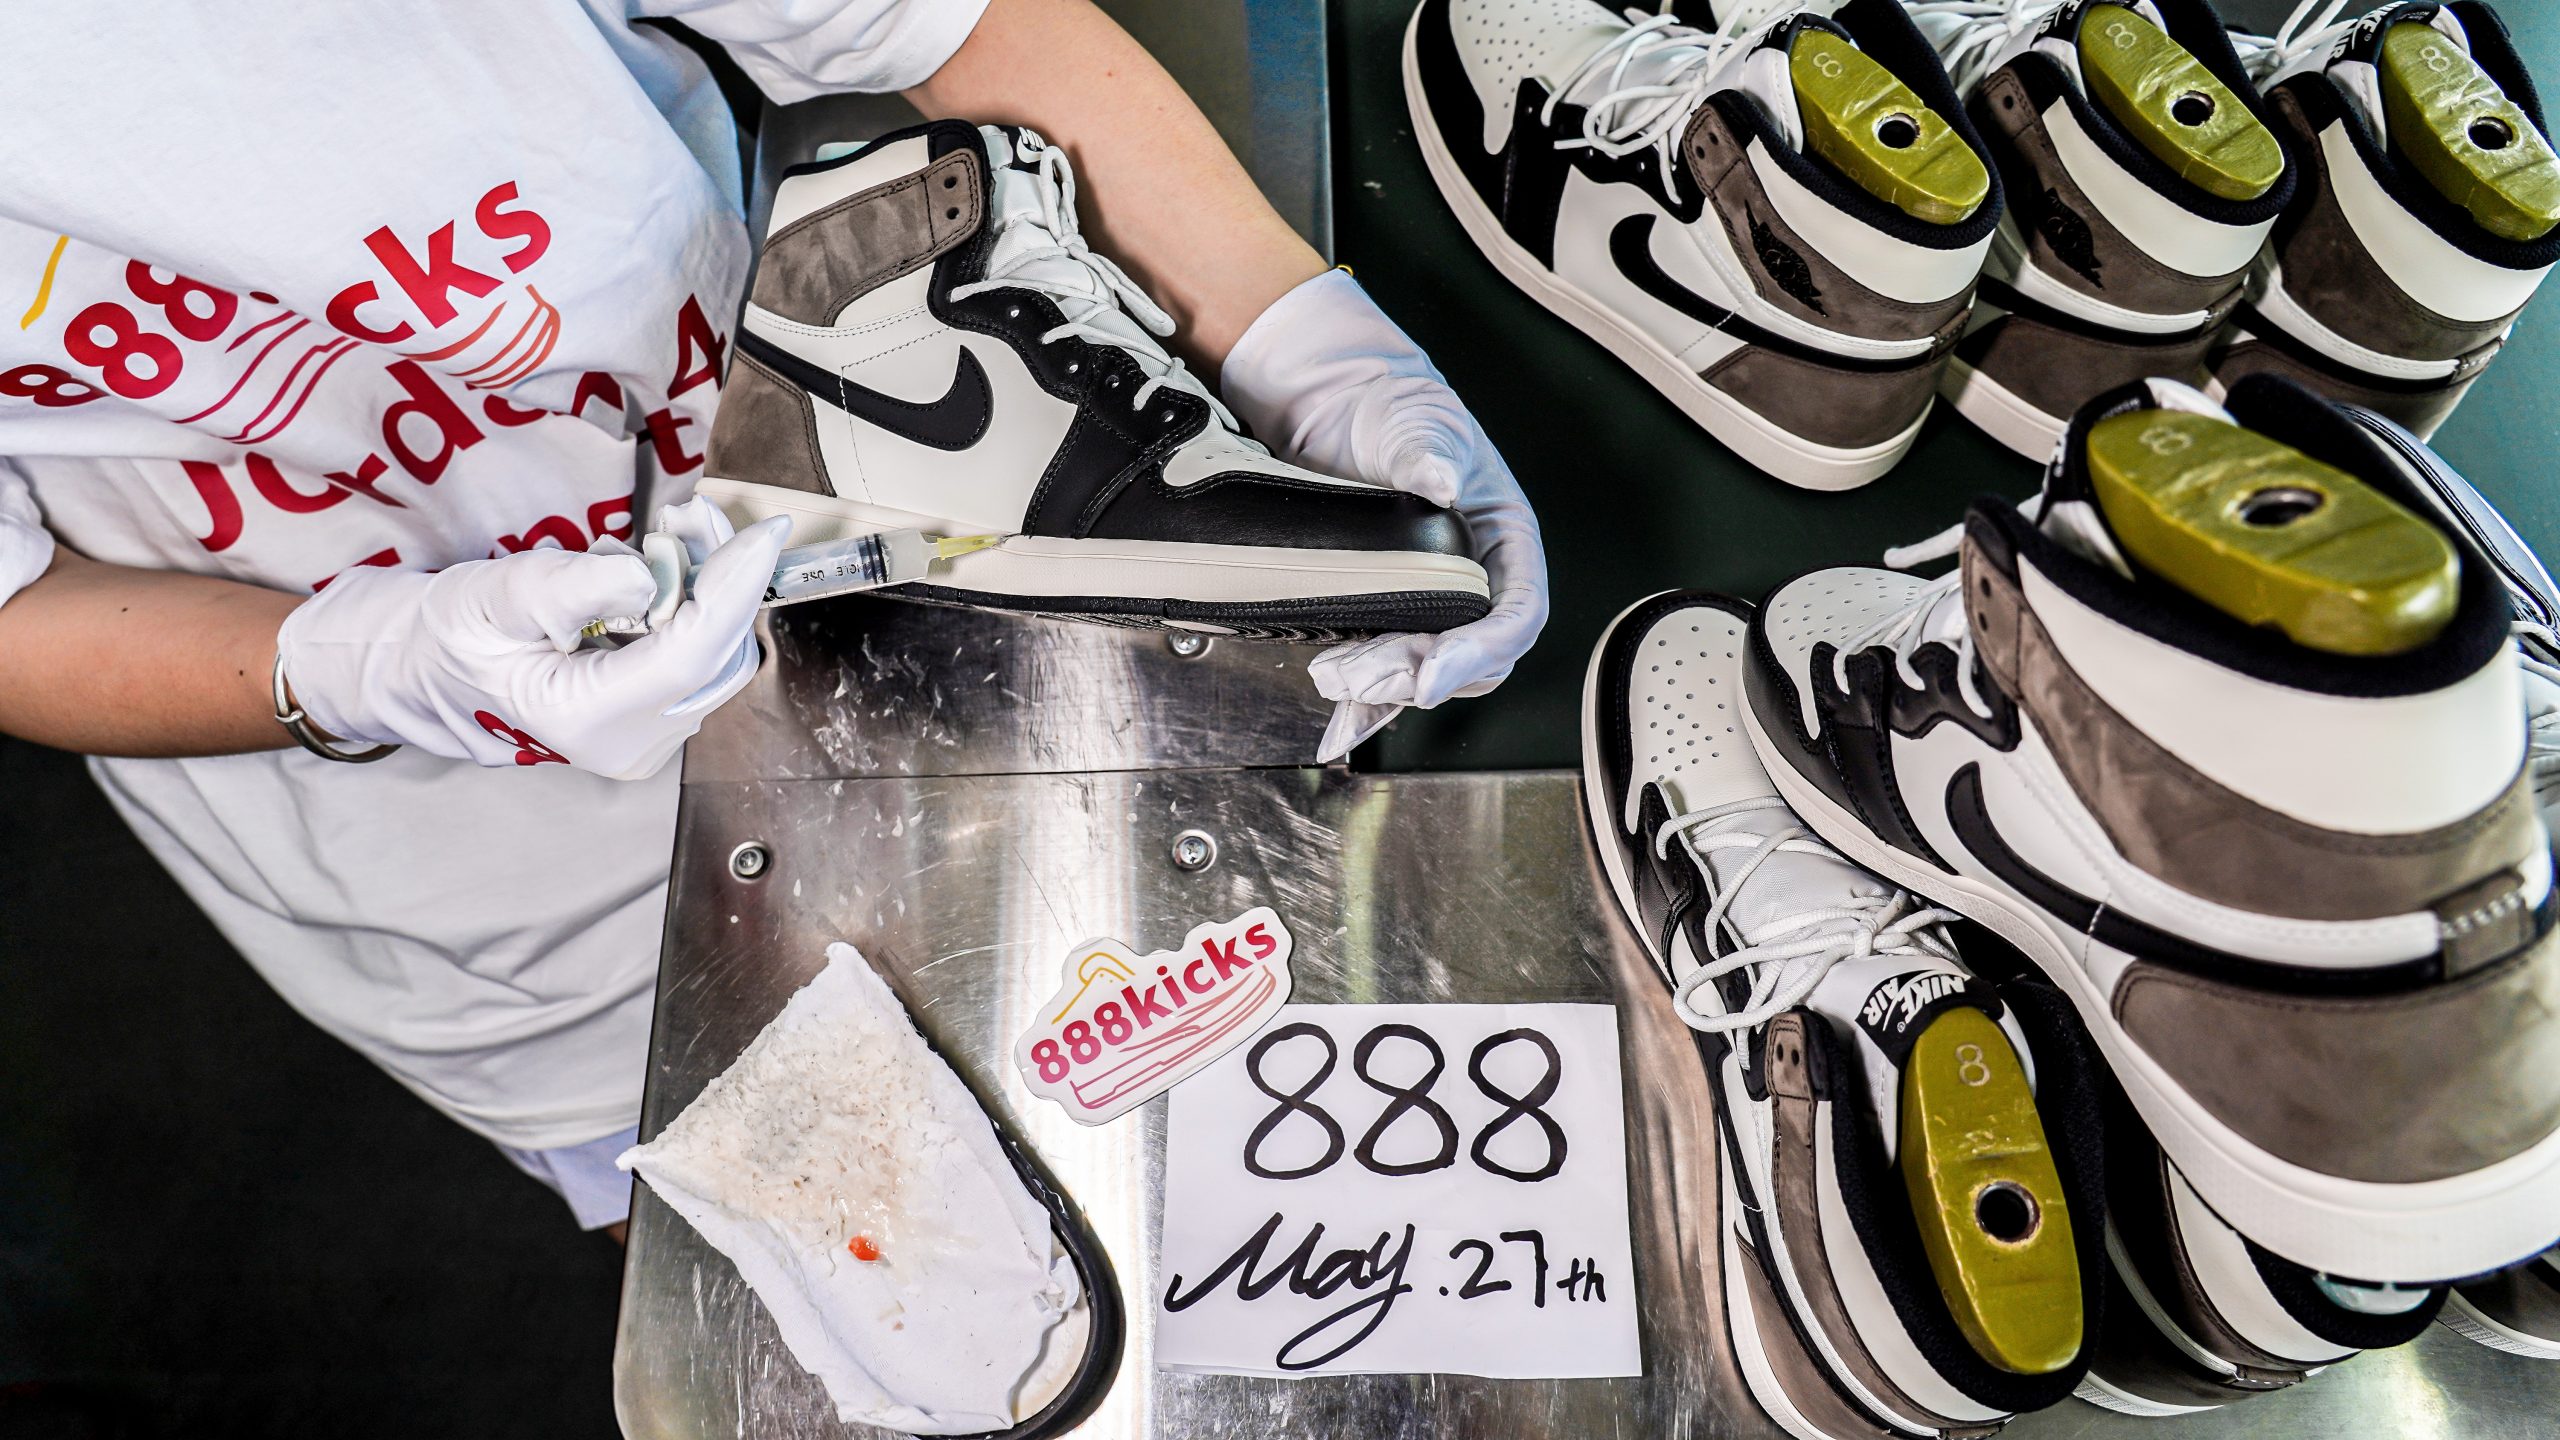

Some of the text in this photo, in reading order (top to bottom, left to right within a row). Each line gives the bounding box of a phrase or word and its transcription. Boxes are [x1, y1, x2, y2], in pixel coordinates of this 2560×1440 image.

[2105, 23, 2137, 51] 8
[2420, 46, 2451, 73] 8
[1813, 52, 1843, 78] 8
[667, 293, 727, 402] 4
[1029, 920, 1278, 1085] 888kicks
[1863, 977, 1901, 1026] AIR
[1900, 975, 1966, 1025] NIKE
[1955, 1043, 1991, 1087] 8
[1243, 1021, 1568, 1182] 888
[1163, 1211, 1415, 1370] May
